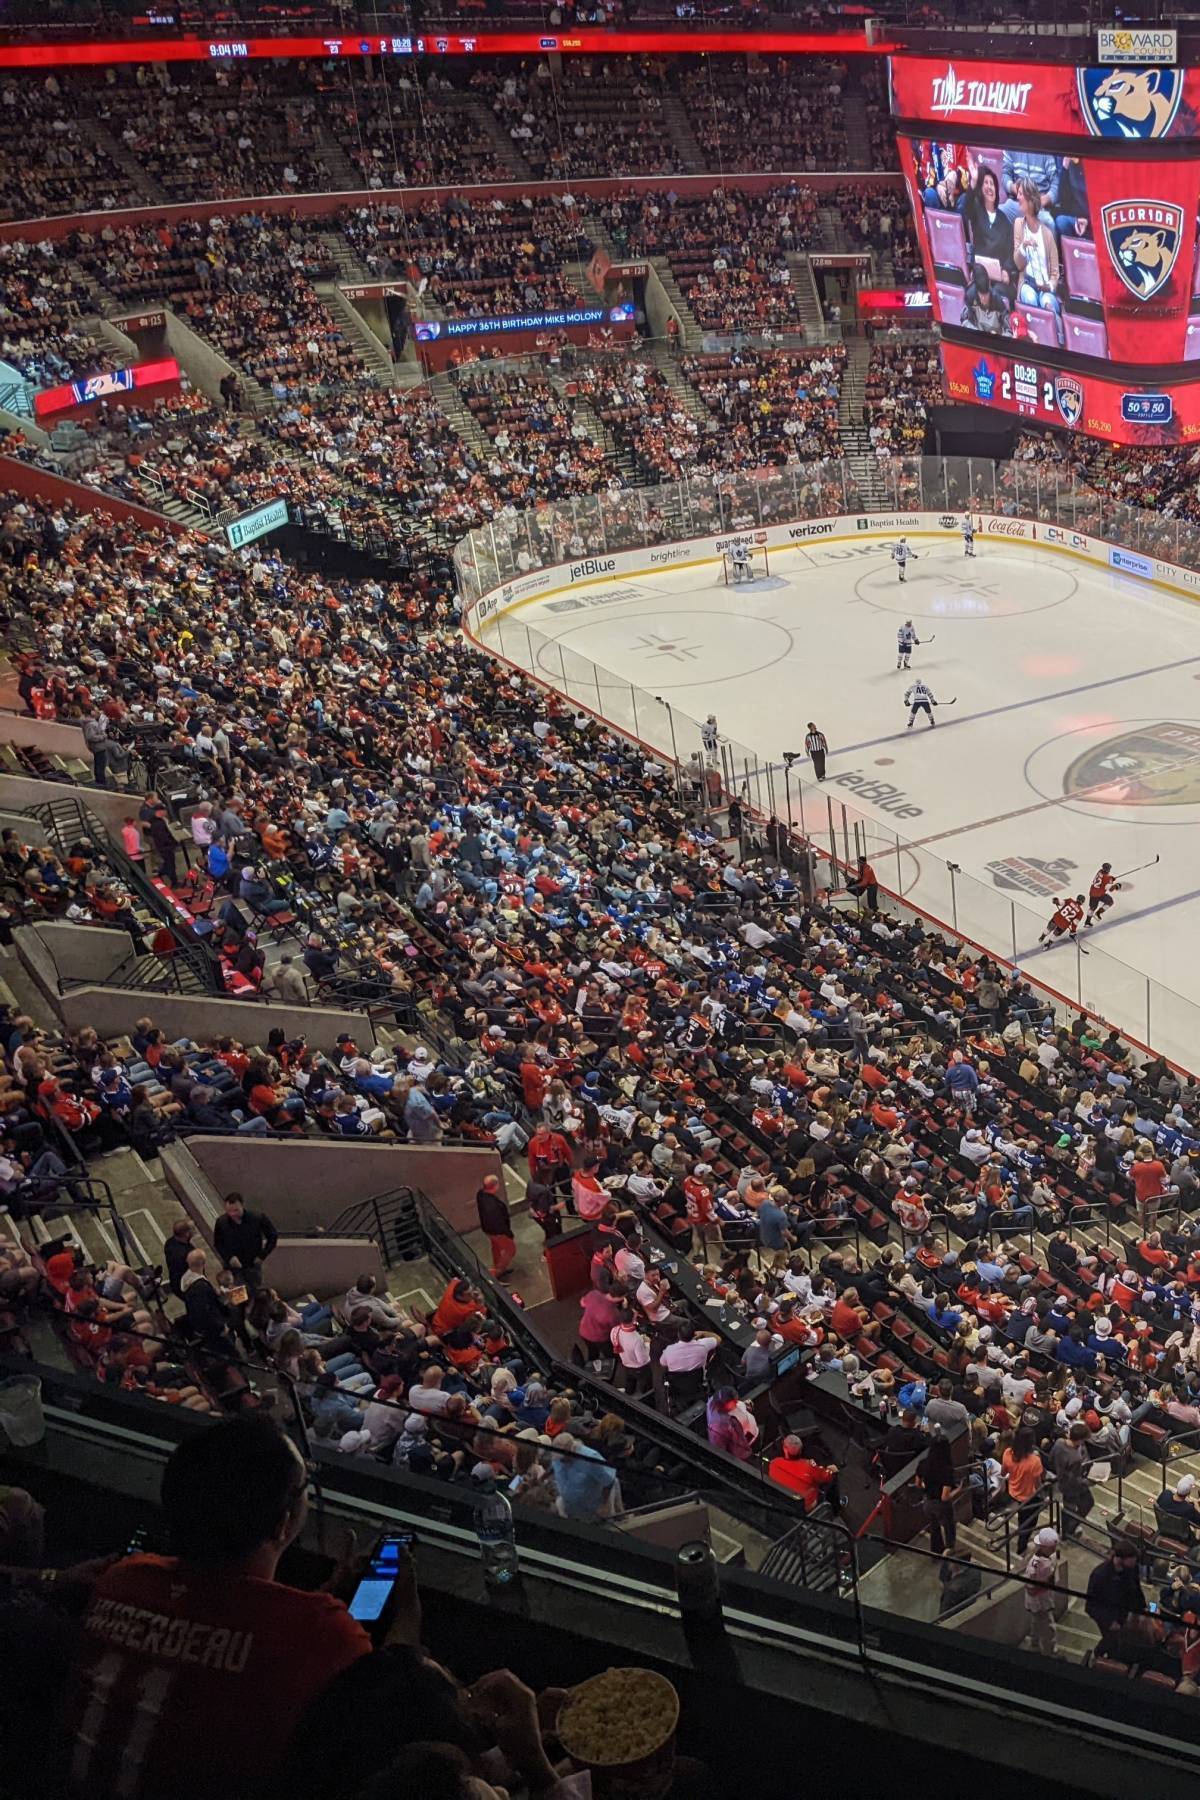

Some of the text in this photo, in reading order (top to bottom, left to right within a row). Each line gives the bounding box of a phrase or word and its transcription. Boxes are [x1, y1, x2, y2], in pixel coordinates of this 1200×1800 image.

[381, 40, 387, 52] 2
[391, 39, 412, 48] 00:28
[417, 40, 424, 51] 2
[1101, 33, 1173, 47] BROWARD
[210, 43, 248, 56] 9:04 PM
[932, 64, 1033, 112] TIME TO HUNT
[1111, 208, 1174, 226] FLORIDA
[904, 292, 930, 305] TIME
[448, 311, 603, 335] HAPPY 36TH BIRTHDAY MIKE MOLONY
[1014, 364, 1037, 383] 00:28
[950, 382, 970, 394] $56,290
[1002, 372, 1011, 399] 2
[1058, 379, 1080, 390] FLORIDA
[1044, 382, 1054, 411] 2
[1127, 402, 1165, 413] 50 50
[1088, 419, 1111, 433] $56,290
[243, 508, 285, 536] Baptist Health
[870, 518, 920, 529] Baptist Health
[789, 523, 832, 538] verizon
[1048, 528, 1064, 541] CH
[1073, 536, 1087, 549] CH
[651, 547, 690, 563] brightline
[1113, 552, 1148, 572] enterprise
[570, 560, 616, 582] jetBlue
[1156, 564, 1177, 577] CITY
[822, 769, 924, 820] jetBlue
[1060, 906, 1077, 921] 62
